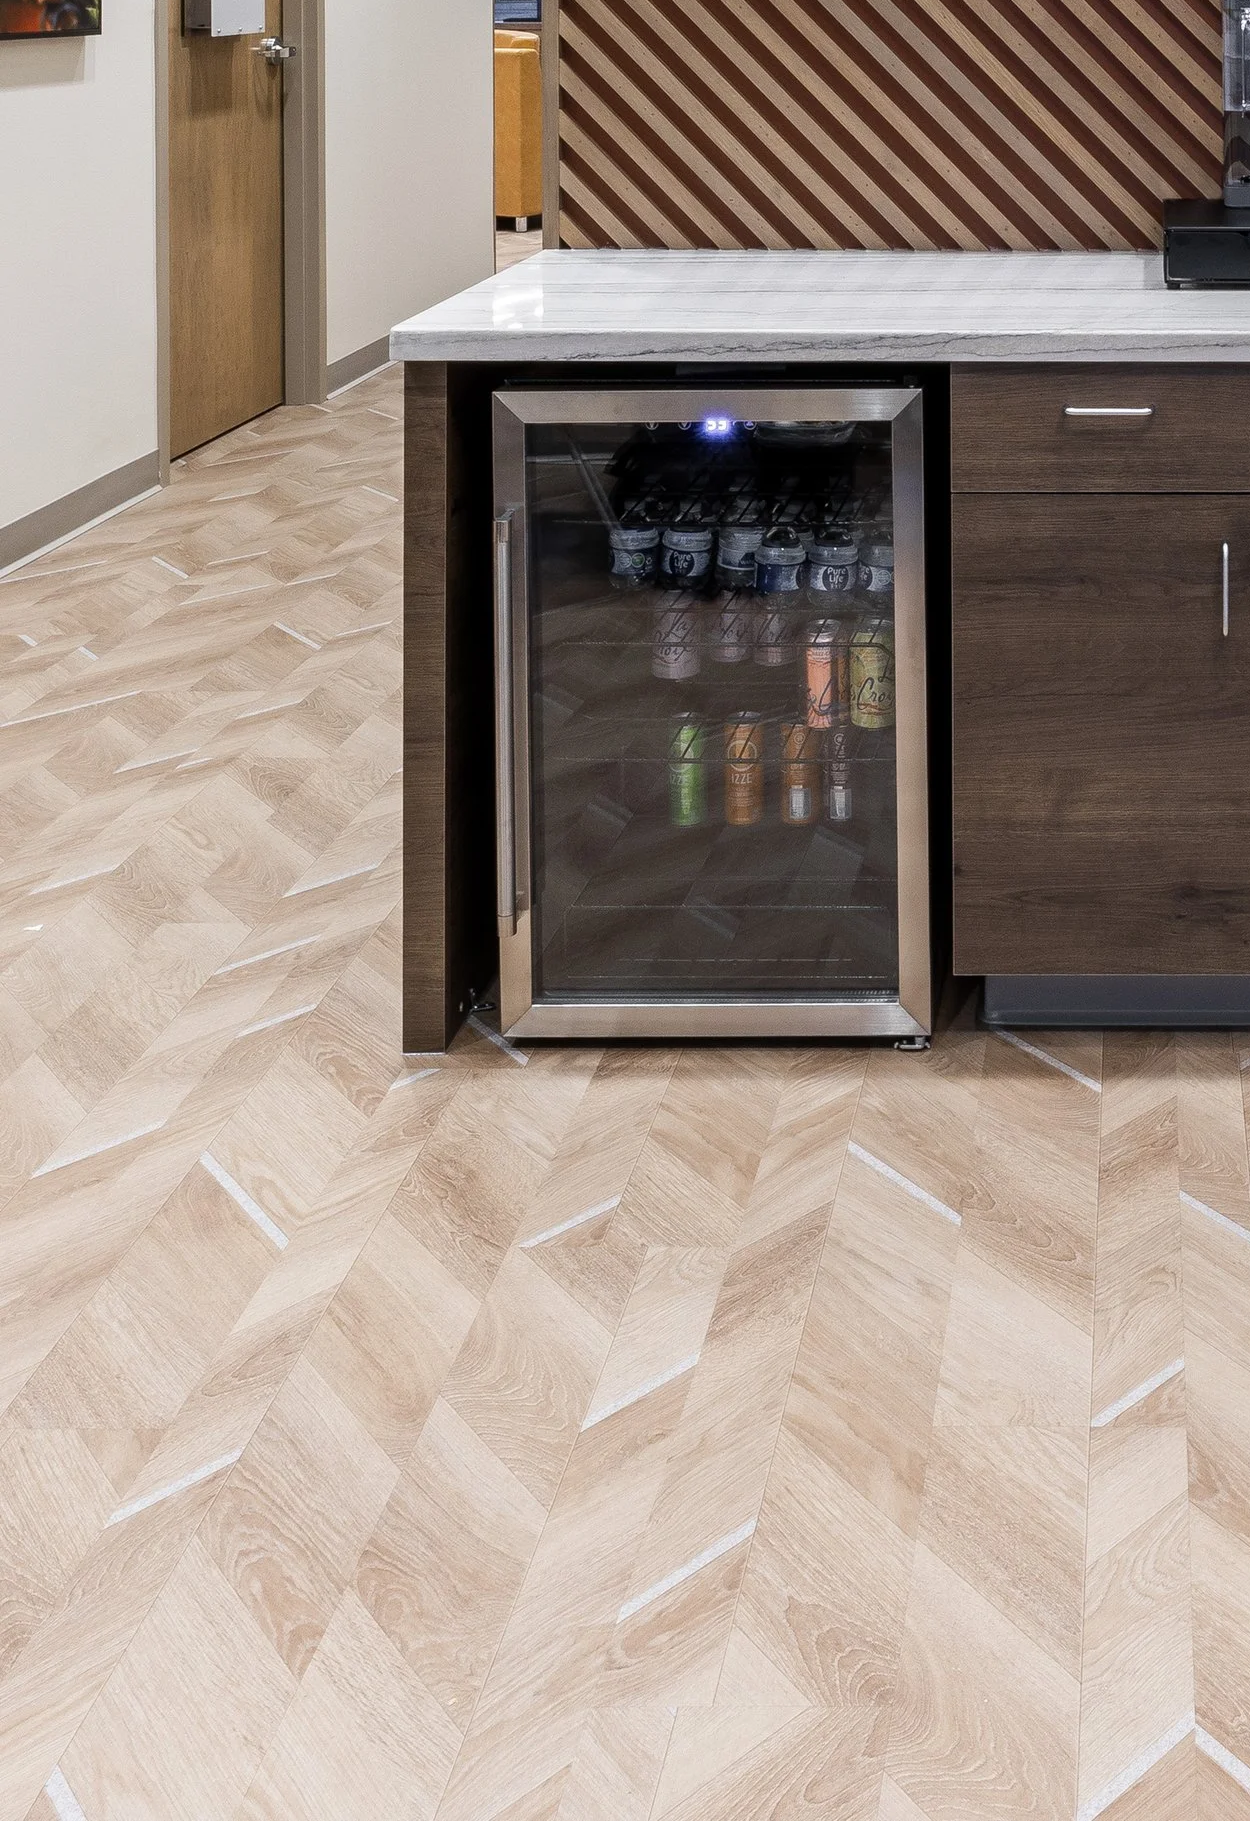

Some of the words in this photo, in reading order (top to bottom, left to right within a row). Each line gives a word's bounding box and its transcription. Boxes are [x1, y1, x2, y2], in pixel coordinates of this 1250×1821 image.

[827, 566, 847, 576] Pure
[829, 575, 844, 584] Life
[731, 773, 753, 785] IZZE
